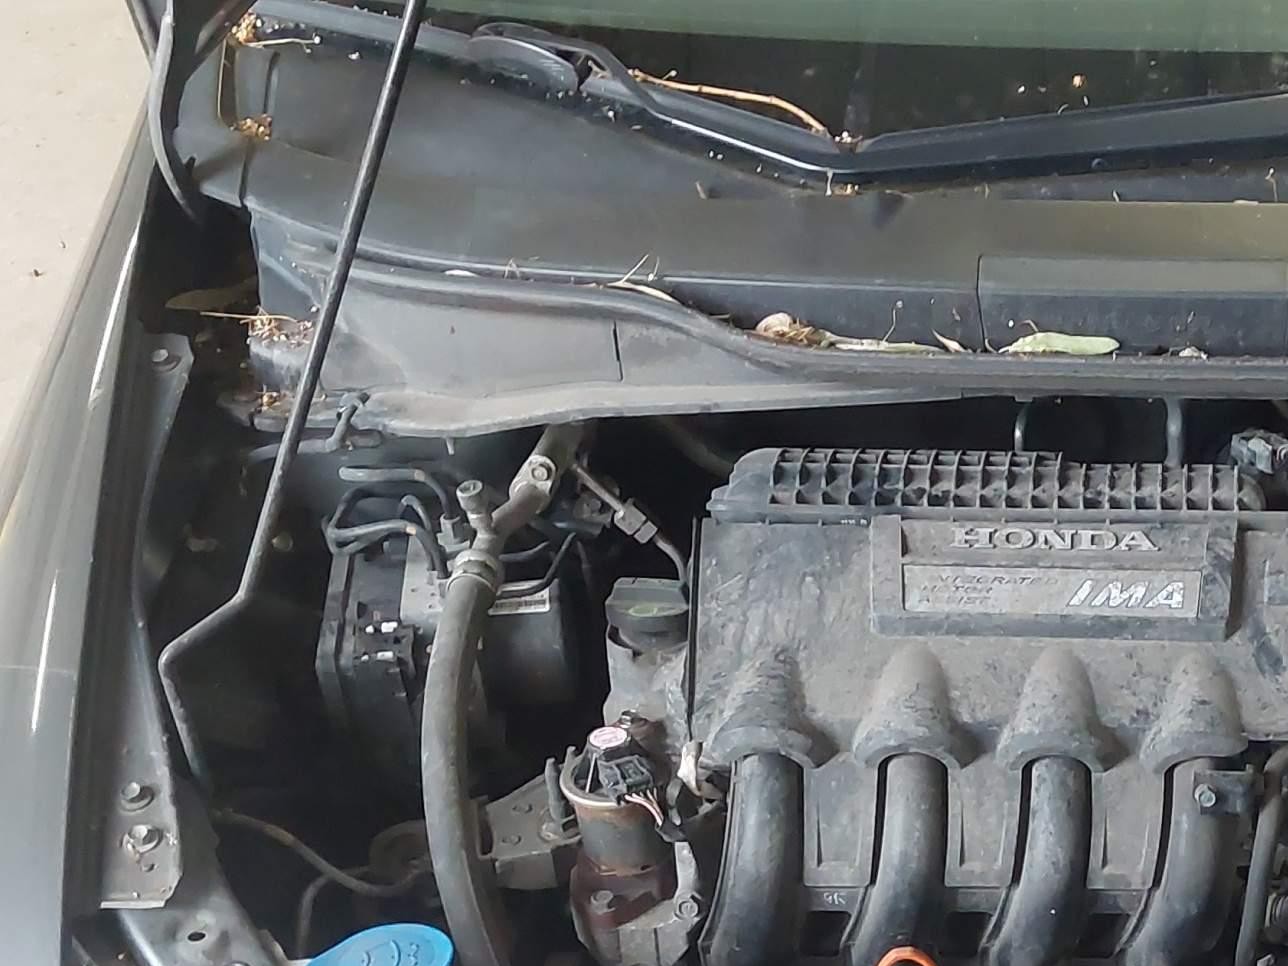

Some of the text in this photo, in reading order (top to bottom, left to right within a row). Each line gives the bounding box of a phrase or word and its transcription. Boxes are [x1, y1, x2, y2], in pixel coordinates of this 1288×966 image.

[951, 527, 1161, 551] HONDA
[932, 575, 1062, 584] NTEGRATED
[1066, 579, 1184, 608] IMA
